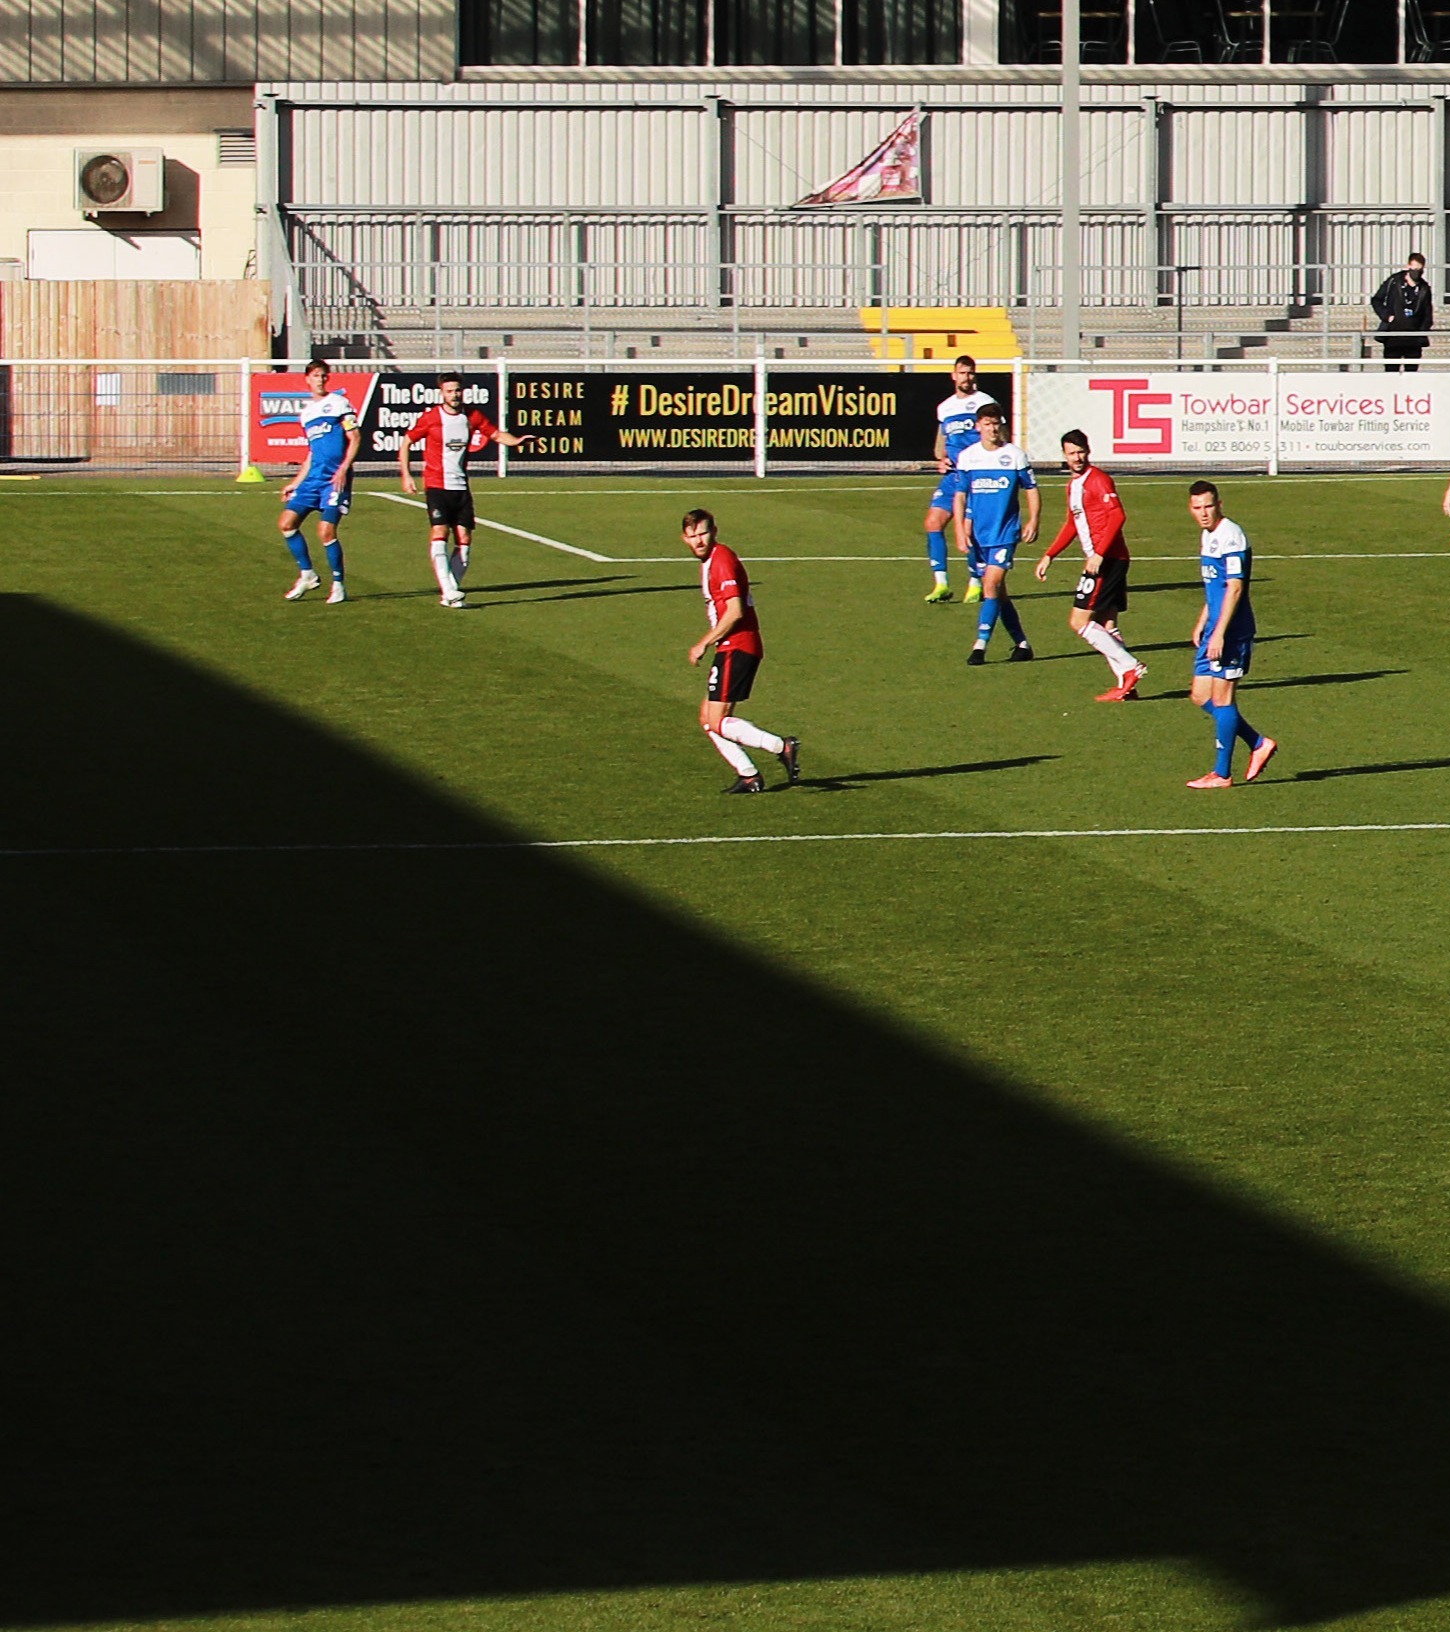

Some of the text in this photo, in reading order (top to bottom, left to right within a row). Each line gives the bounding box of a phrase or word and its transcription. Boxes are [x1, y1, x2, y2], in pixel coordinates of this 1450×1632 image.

[381, 384, 411, 405] The
[516, 382, 586, 399] DESIRE
[611, 385, 629, 416] #
[1181, 393, 1432, 416] Towbar Services Ltd
[517, 409, 583, 426] DREAM
[1247, 419, 1269, 432] No.1
[1280, 419, 1315, 432] Mobile
[1319, 419, 1354, 432] Towbar
[1358, 419, 1389, 435] Fitting
[1393, 419, 1430, 432] Service
[1204, 440, 1227, 452] 023
[329, 492, 339, 506] 2
[995, 548, 1007, 564] 4
